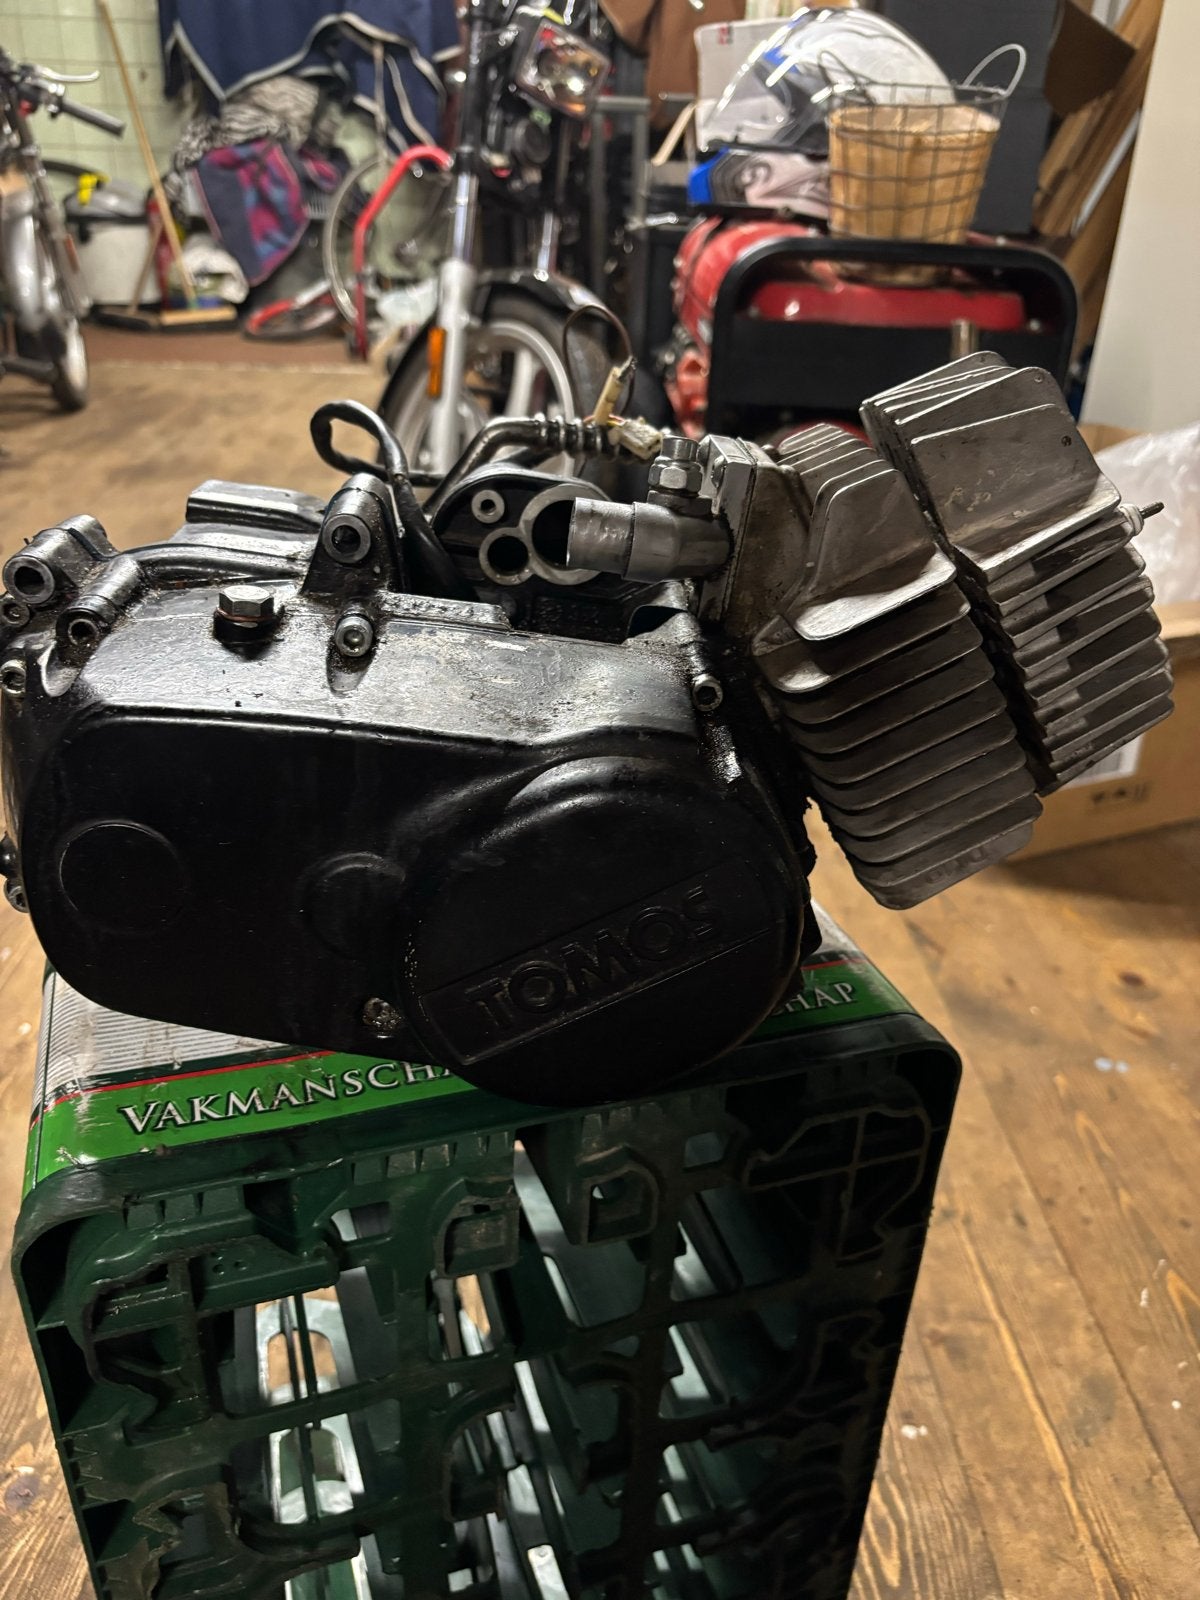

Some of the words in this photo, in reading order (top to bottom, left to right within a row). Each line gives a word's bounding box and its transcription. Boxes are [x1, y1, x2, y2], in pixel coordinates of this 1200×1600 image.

[464, 885, 721, 1028] TOMOS
[121, 1060, 451, 1133] VAKMANSCH
[771, 982, 857, 1016] HAP
